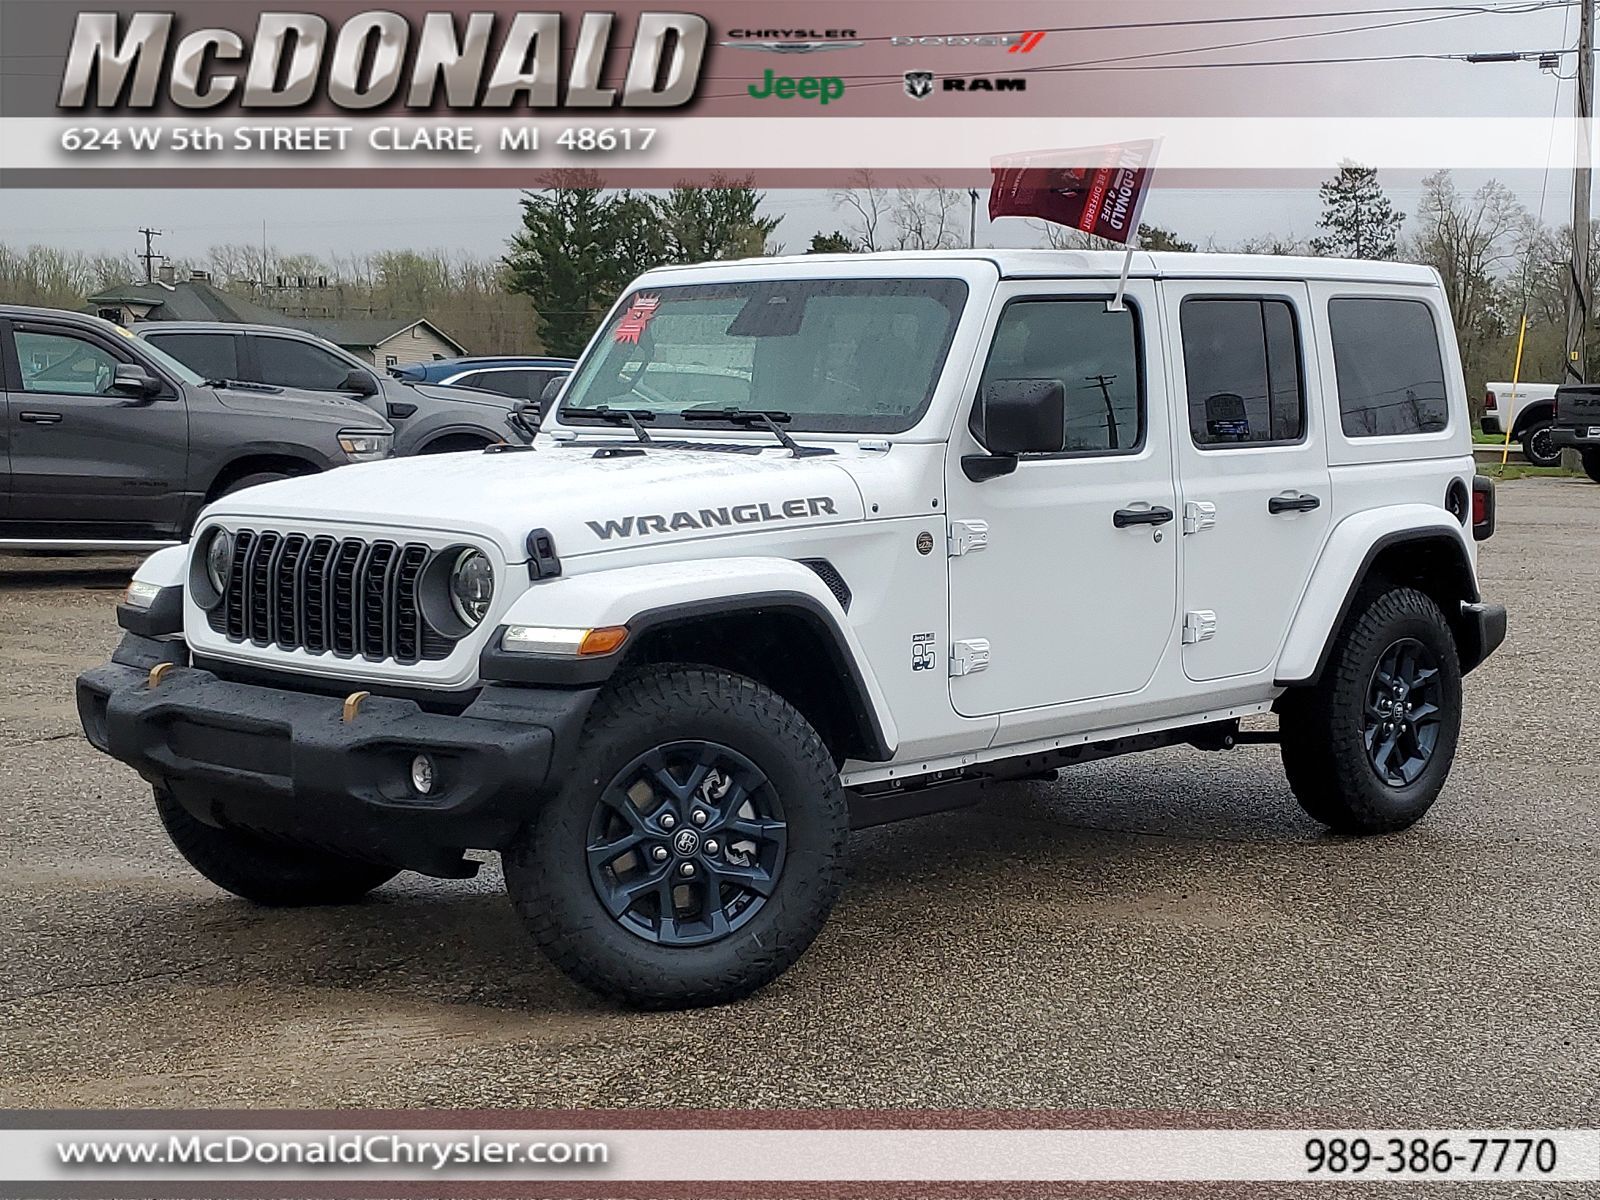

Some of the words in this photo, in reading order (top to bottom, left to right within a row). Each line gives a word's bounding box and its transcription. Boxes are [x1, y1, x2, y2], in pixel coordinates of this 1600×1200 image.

[1107, 190, 1115, 198] 4
[1110, 148, 1143, 230] McDONALD
[1082, 187, 1102, 231] DIFFERENT
[1101, 199, 1113, 222] LIFE
[585, 496, 839, 540] WRANGLER
[912, 641, 936, 671] 85
